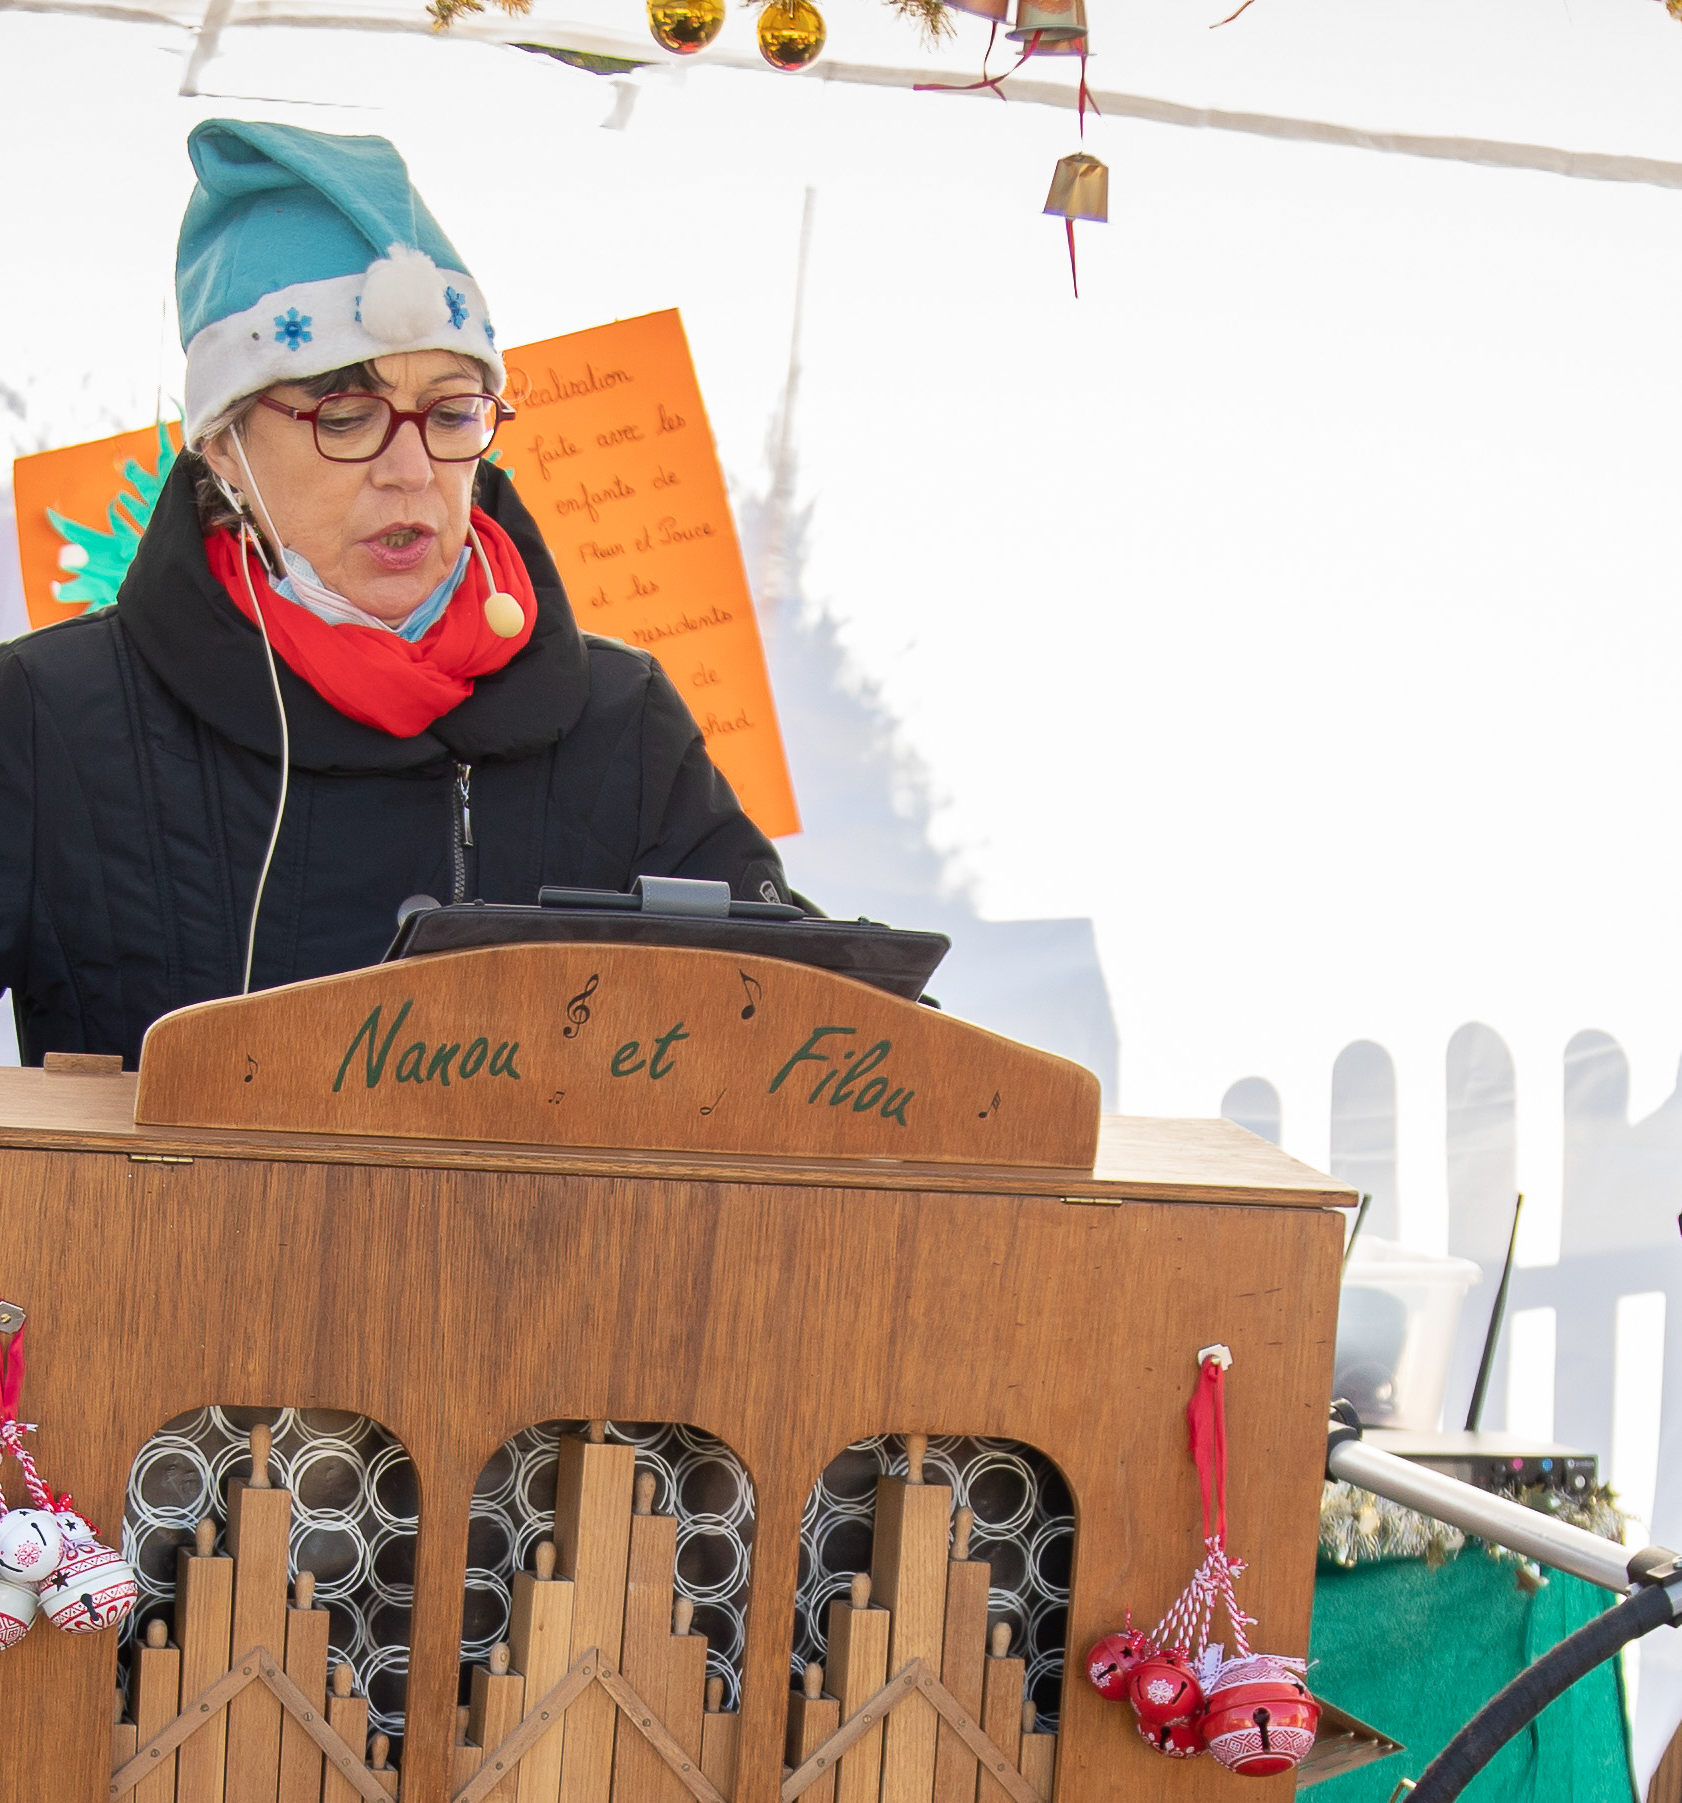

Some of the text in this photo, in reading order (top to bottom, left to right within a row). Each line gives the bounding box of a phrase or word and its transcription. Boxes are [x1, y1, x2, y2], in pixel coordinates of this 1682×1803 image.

[527, 402, 686, 481] faite avec les
[556, 464, 679, 523] enfants de
[635, 525, 652, 551] et
[659, 516, 716, 544] Pouce
[591, 573, 659, 607] et les
[693, 661, 721, 687] de
[332, 1000, 915, 1127] Nanou et Filou
